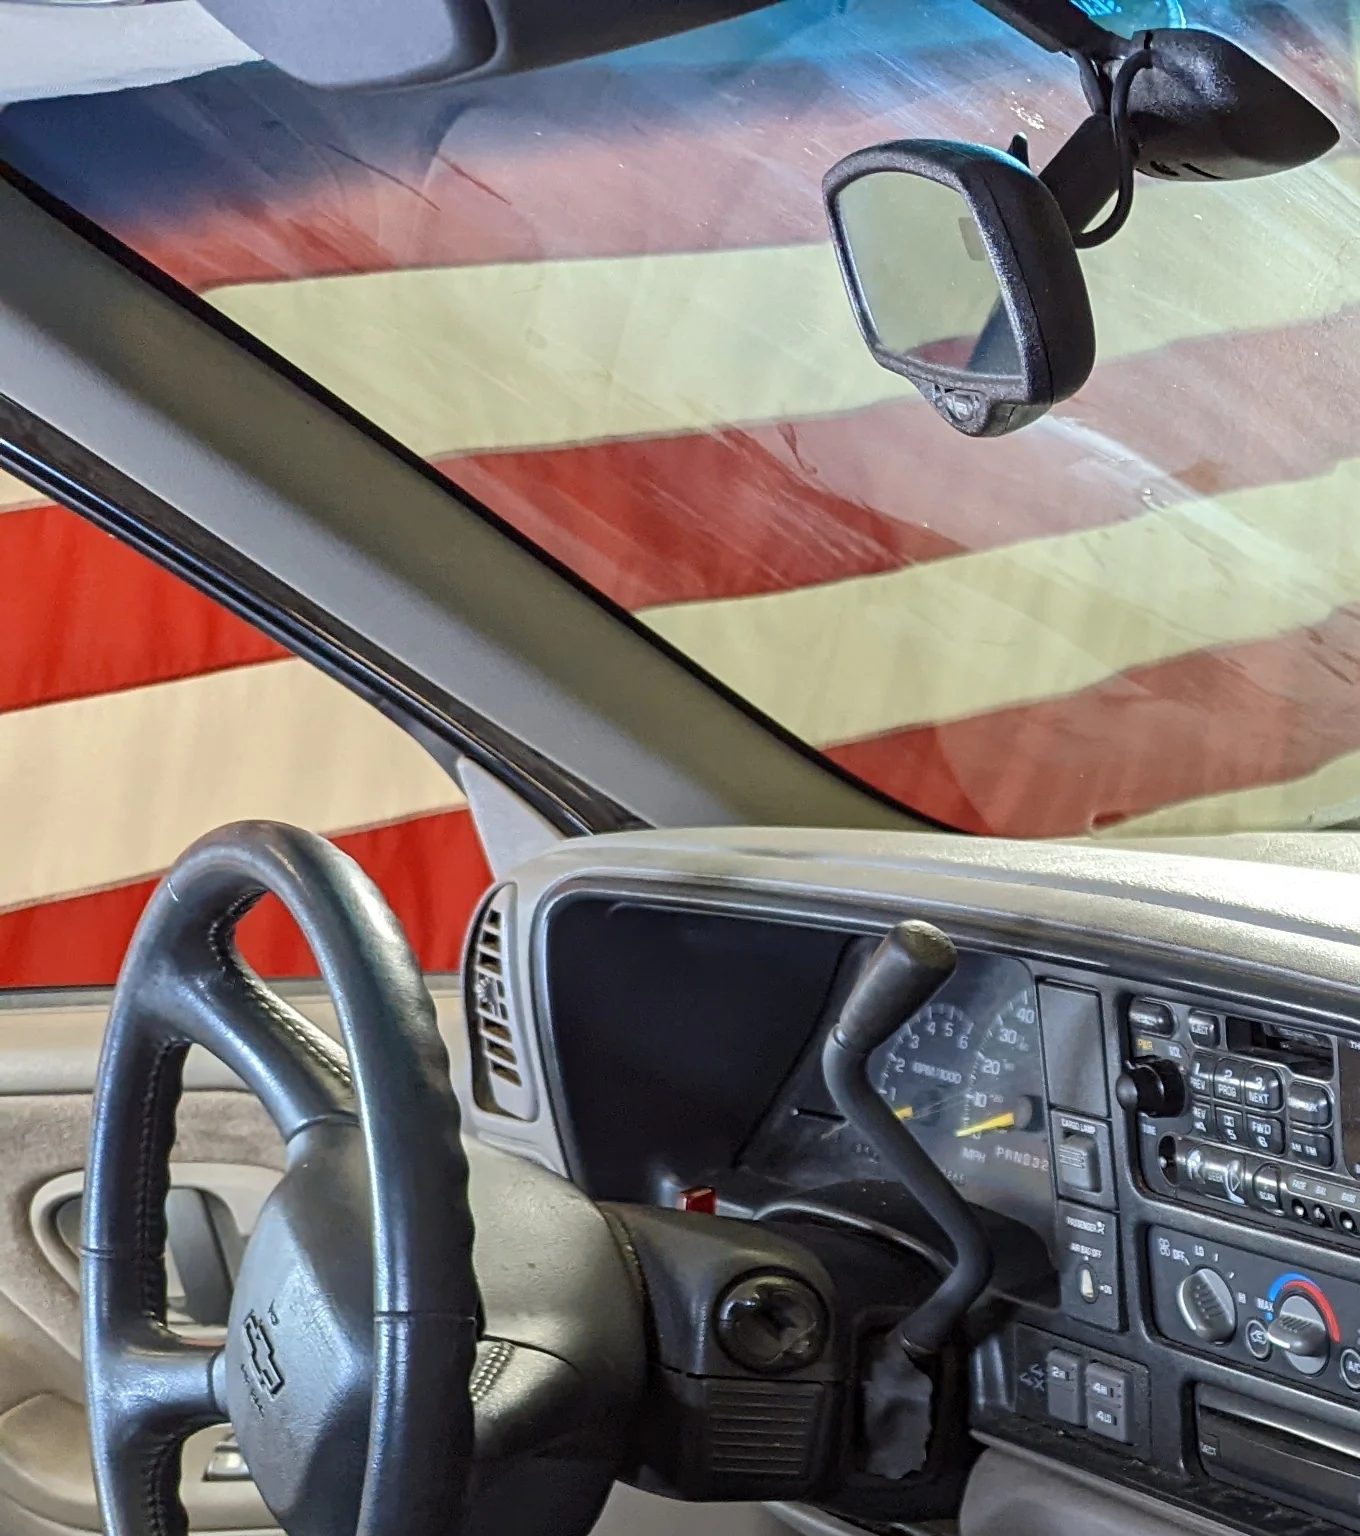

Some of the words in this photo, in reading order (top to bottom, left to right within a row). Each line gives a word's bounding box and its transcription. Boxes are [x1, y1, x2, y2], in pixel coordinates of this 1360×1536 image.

[1016, 1007, 1034, 1024] 40
[928, 1022, 936, 1035] 4
[945, 1022, 953, 1036] 5
[1000, 1027, 1017, 1044] 30
[909, 1034, 919, 1049] 3
[959, 1035, 968, 1049] 6
[1169, 1046, 1182, 1058] VOL
[895, 1058, 905, 1072] 2
[983, 1059, 1000, 1075] 20
[1224, 1069, 1233, 1080] 2
[1218, 1084, 1237, 1098] PROG
[1255, 1077, 1265, 1091] 3
[974, 1092, 987, 1108] 10
[1249, 1091, 1269, 1104] NEXT
[1227, 1128, 1237, 1140] 5
[1252, 1121, 1271, 1135] FWD
[1257, 1136, 1268, 1147] 6
[962, 1148, 986, 1163] MPH
[1173, 1250, 1186, 1262] OFF
[1258, 1298, 1274, 1313] MAX
